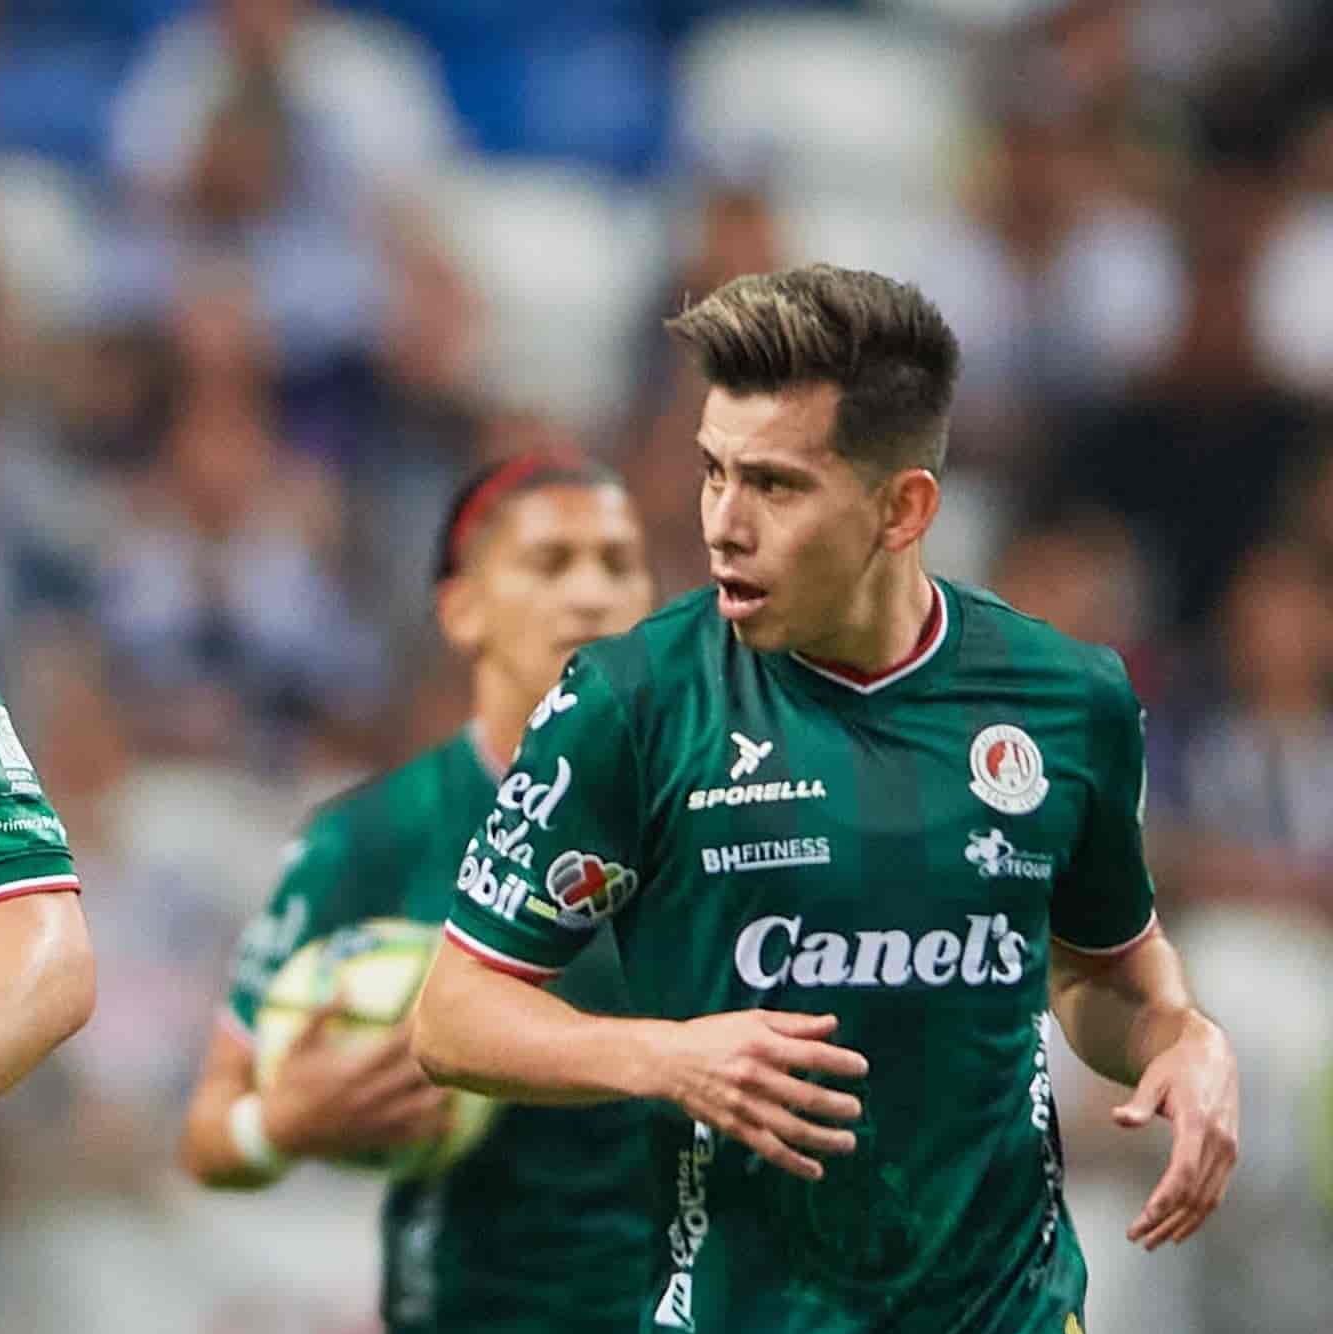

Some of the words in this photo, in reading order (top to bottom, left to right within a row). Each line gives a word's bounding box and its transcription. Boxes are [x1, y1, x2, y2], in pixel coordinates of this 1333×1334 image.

[496, 756, 572, 831] ed
[457, 838, 530, 921] obil
[735, 912, 1030, 990] Canel's
